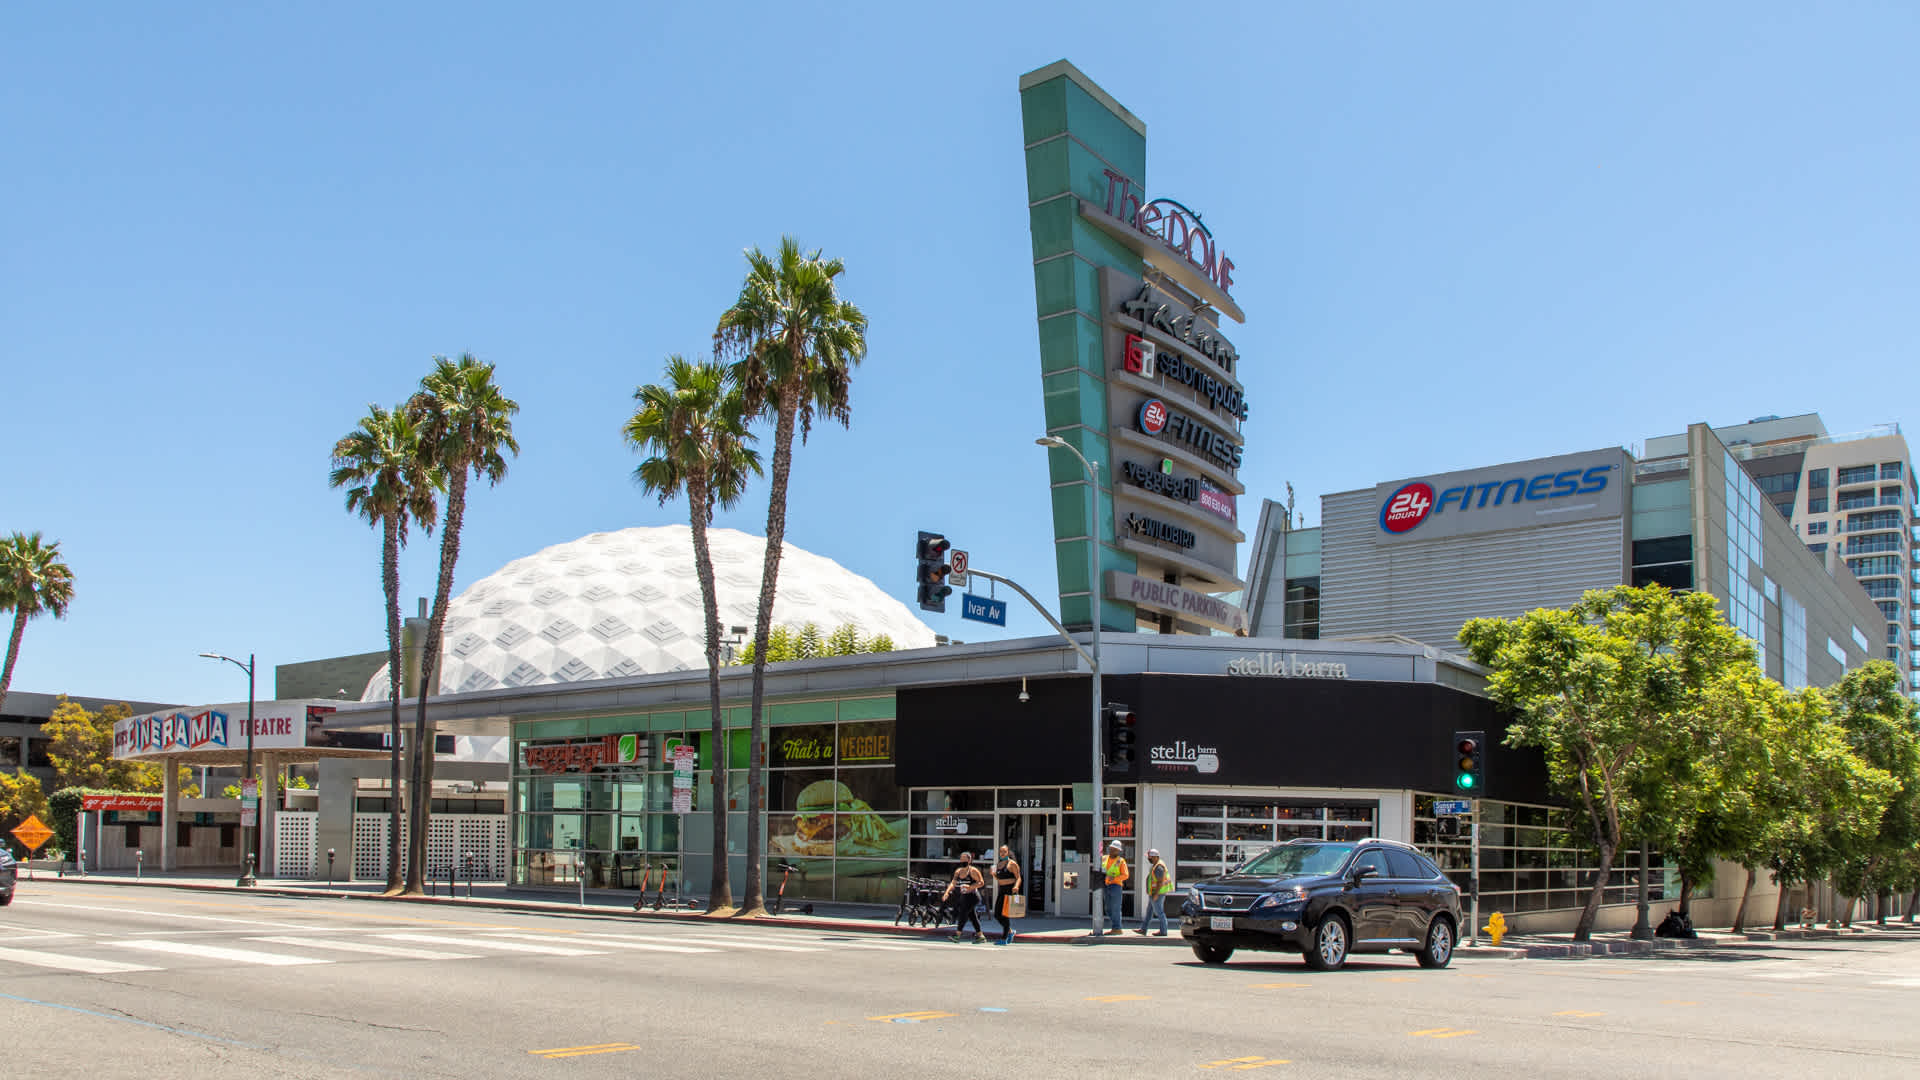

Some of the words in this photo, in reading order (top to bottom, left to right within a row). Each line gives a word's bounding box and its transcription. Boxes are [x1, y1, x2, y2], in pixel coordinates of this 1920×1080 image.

[1147, 404, 1165, 426] 24
[1434, 465, 1612, 514] FITNESS
[1388, 510, 1415, 521] HOUR
[1391, 491, 1431, 518] 24
[968, 600, 985, 617] Ivar
[988, 605, 1001, 620] Av
[1131, 579, 1179, 608] PUBLIC
[1182, 591, 1228, 624] PARKING
[1226, 652, 1288, 677] stella
[1289, 653, 1349, 679] barra
[127, 711, 228, 750] CINERAMA
[783, 739, 820, 760] That's
[823, 745, 834, 759] a
[841, 735, 890, 758] VEGGIE!
[1151, 740, 1197, 760] stella
[1197, 745, 1217, 754] barra
[1016, 799, 1041, 808] 6372
[935, 815, 958, 827] stella
